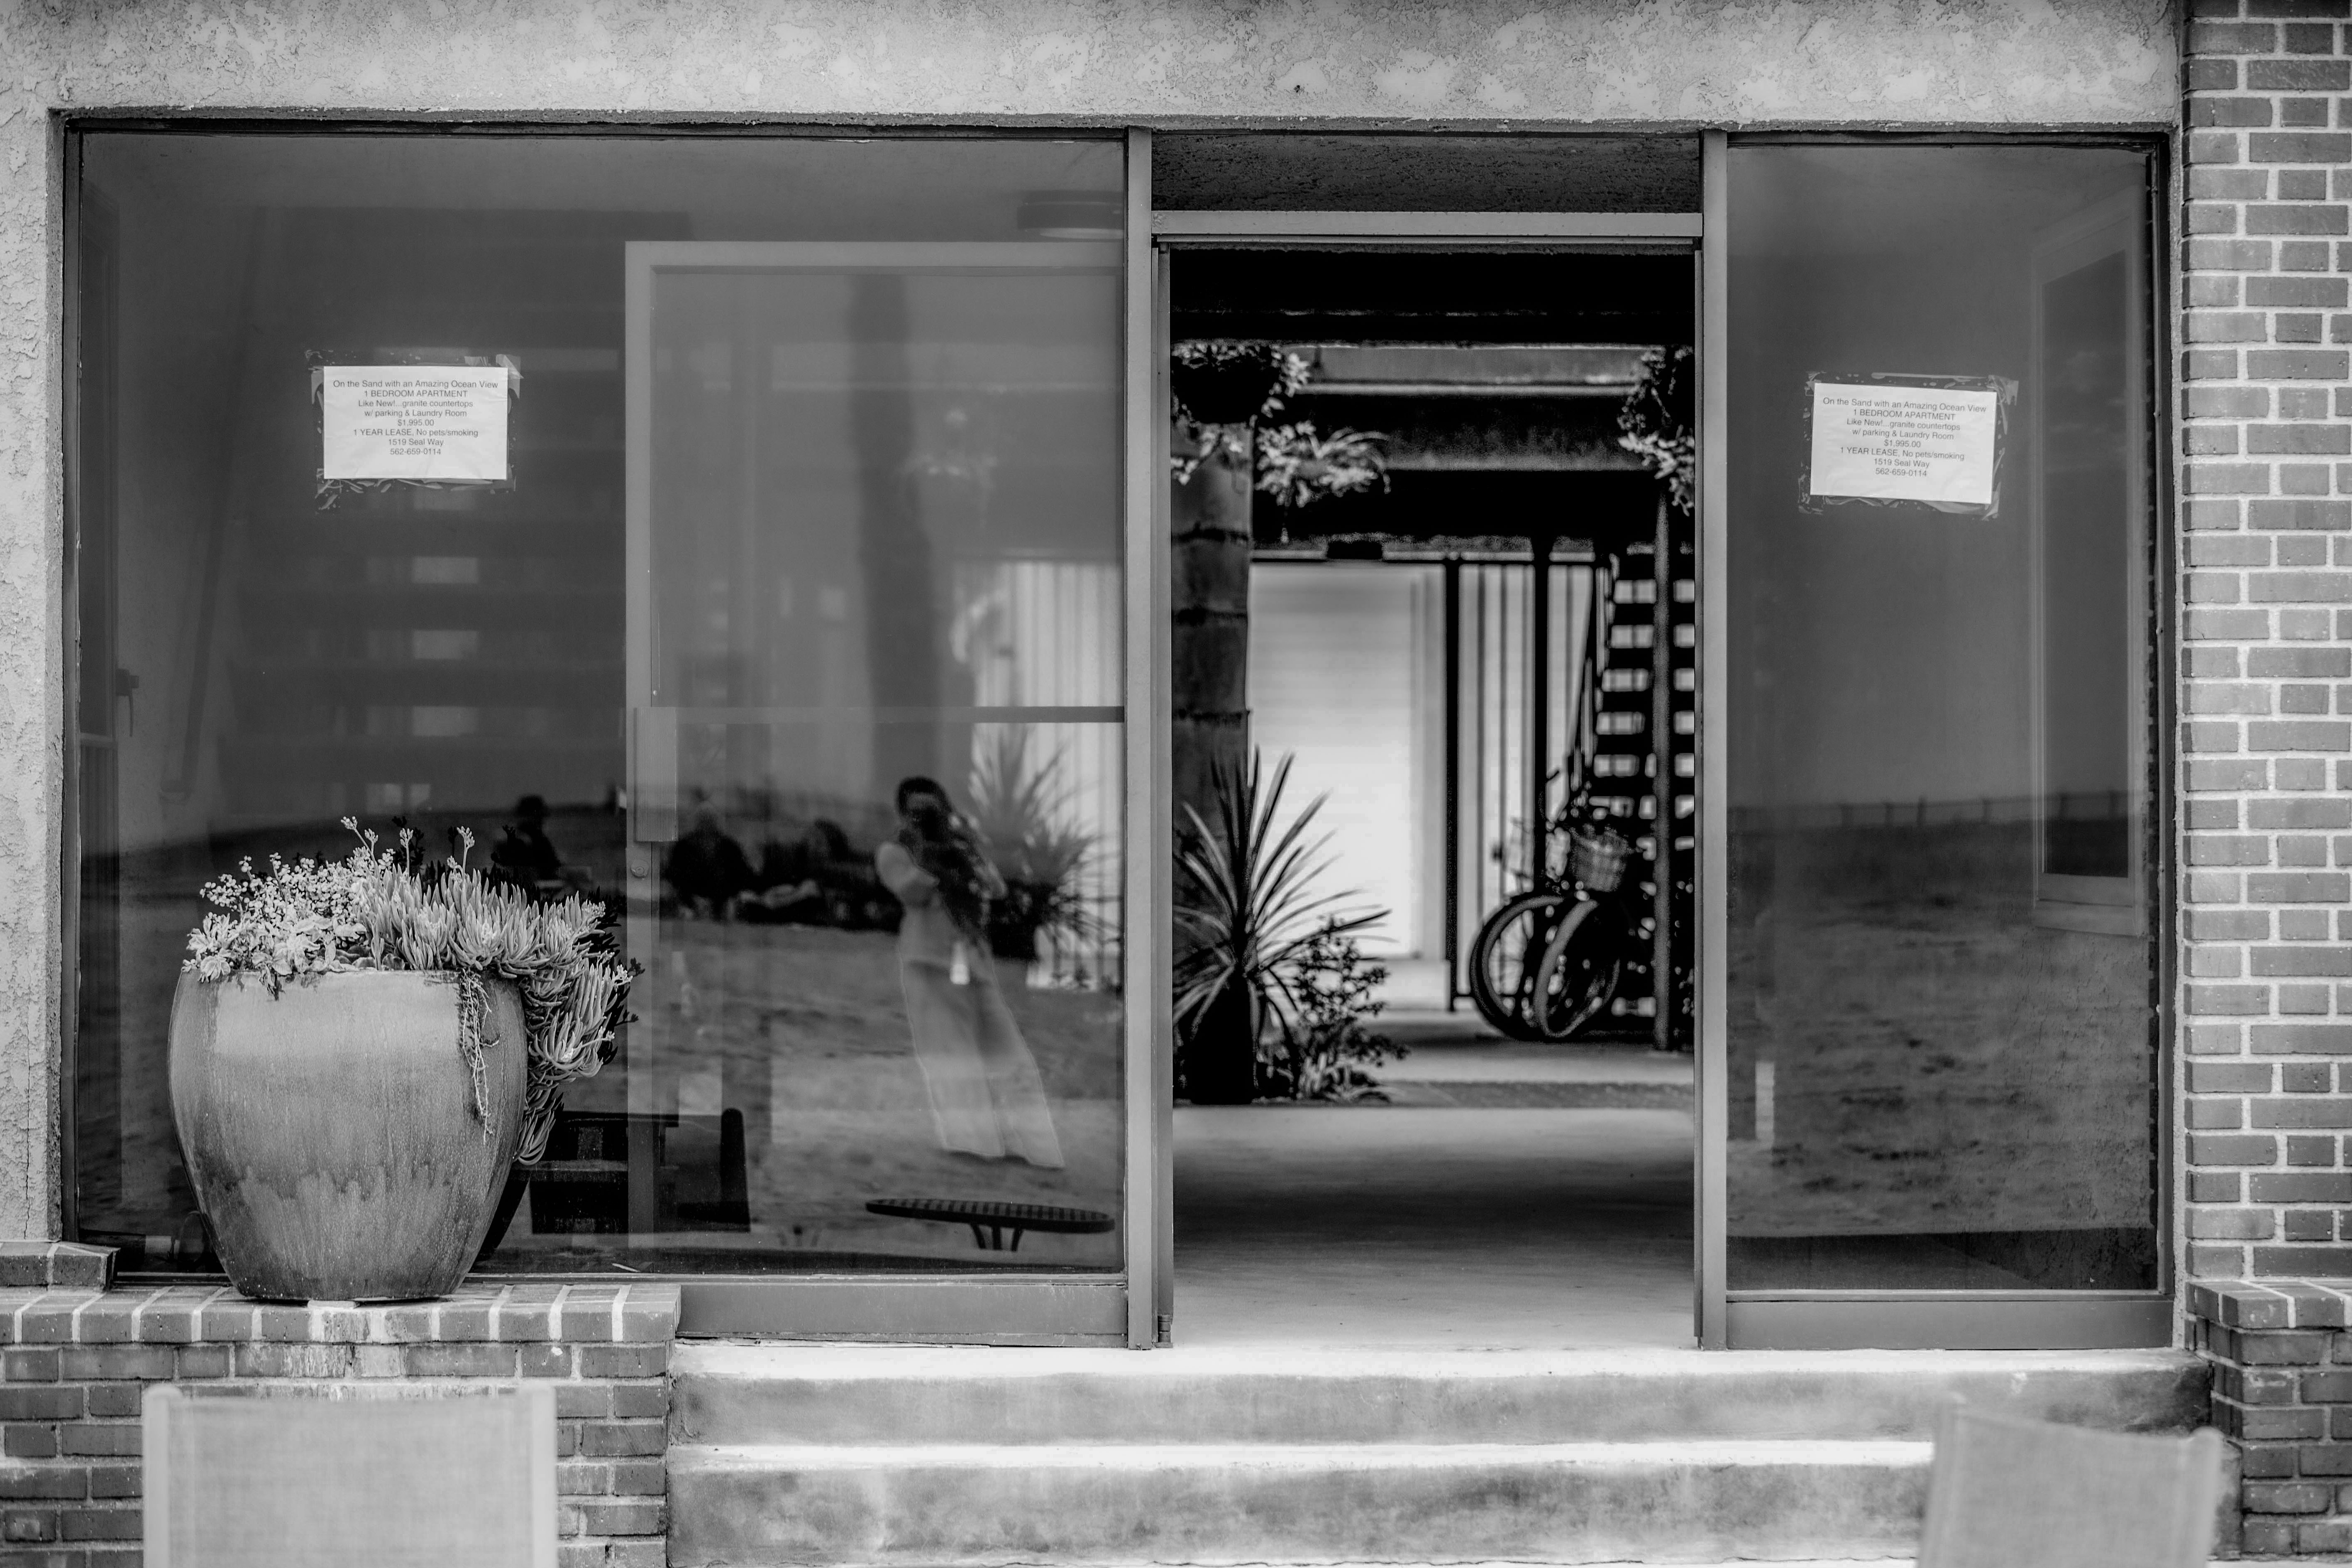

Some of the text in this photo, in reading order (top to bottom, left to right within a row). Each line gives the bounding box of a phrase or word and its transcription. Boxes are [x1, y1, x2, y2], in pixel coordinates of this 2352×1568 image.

[415, 380, 448, 389] Amazing
[1903, 402, 1937, 411] Amazing
[1939, 403, 1965, 411] Ocean
[375, 410, 402, 418] parking
[412, 409, 442, 418] Laundry
[1860, 409, 1902, 418] BEDROOM
[1905, 411, 1956, 420] APARTMENT
[1917, 422, 1960, 432] countertops
[429, 429, 478, 437] pets/smoking
[1863, 429, 1890, 438] parking
[1900, 431, 1929, 440] Laundry
[427, 438, 444, 447] Way
[1884, 439, 1921, 448] $1,995.00
[1871, 448, 1900, 457] LEASE,
[1915, 452, 1964, 461] pets/smoking
[1913, 460, 1929, 469] Way
[1876, 468, 1927, 476] 562-659-0114
